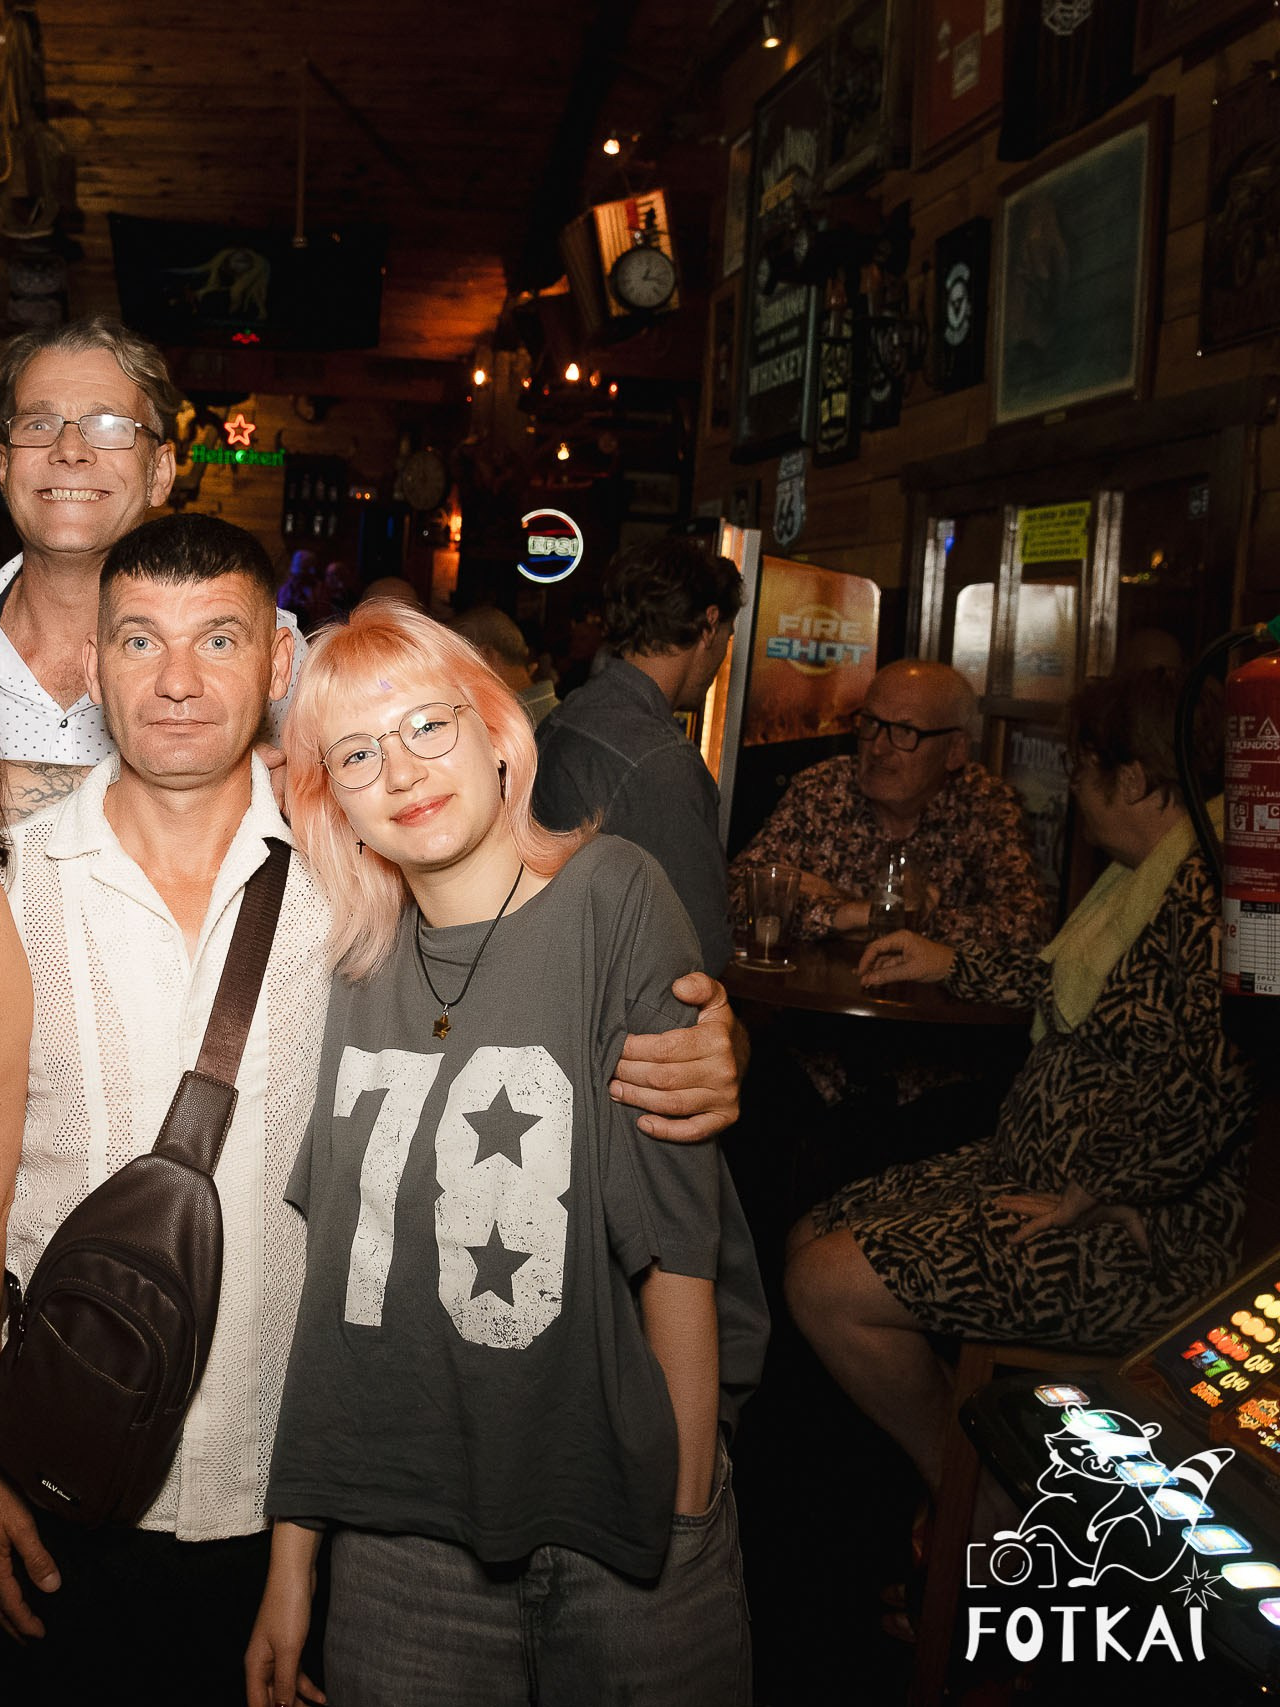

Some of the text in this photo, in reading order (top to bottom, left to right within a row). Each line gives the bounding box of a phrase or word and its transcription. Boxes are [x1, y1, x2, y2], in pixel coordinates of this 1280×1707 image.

[193, 445, 285, 466] Heineken
[778, 614, 862, 641] FIRE
[767, 636, 871, 664] SHOT
[333, 1045, 573, 1350] 78
[1219, 1371, 1252, 1392] 0,40
